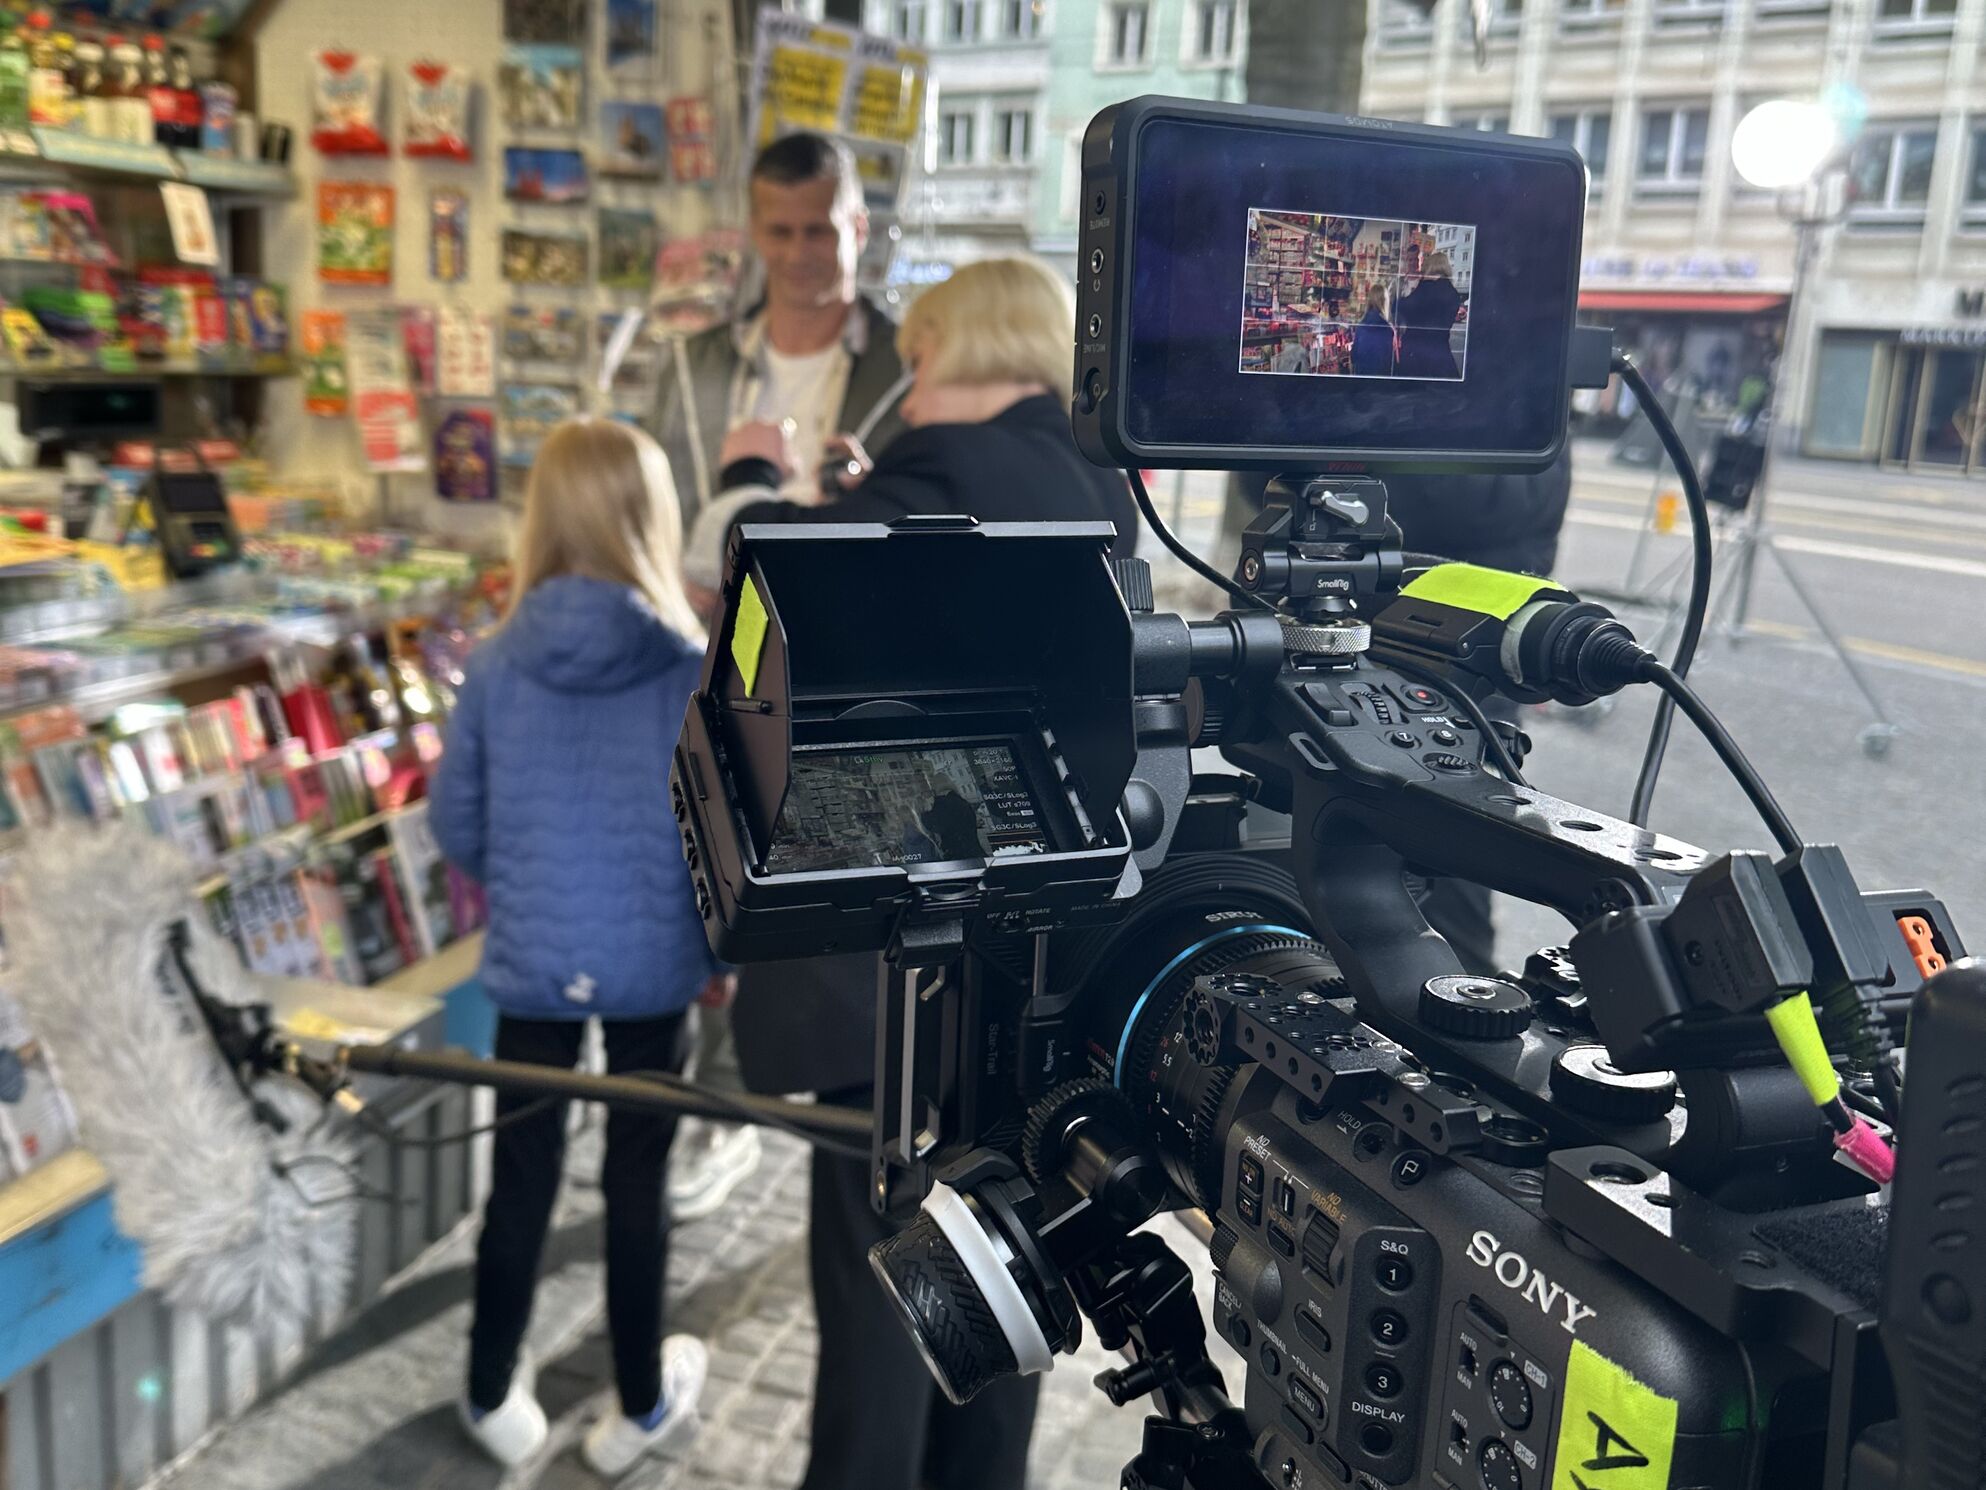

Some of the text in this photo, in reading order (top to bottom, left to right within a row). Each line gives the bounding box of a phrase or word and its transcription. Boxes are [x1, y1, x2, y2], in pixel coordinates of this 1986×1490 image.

[1317, 579, 1349, 591] SmallRig
[1337, 1110, 1361, 1130] HOLD
[1243, 1135, 1272, 1161] PRESET
[1256, 1134, 1271, 1147] ND
[1311, 1190, 1347, 1225] VARIABLE
[1327, 1192, 1341, 1206] ND
[1381, 1239, 1409, 1256] S&Q
[1388, 1268, 1397, 1281] 1
[1466, 1231, 1597, 1334] SONY
[1308, 1299, 1322, 1318] IRIS
[1257, 1319, 1288, 1354] THUMBNAIL
[1383, 1323, 1393, 1336] 2
[1460, 1332, 1478, 1351] AUTO
[1312, 1370, 1330, 1395] MENU
[1377, 1375, 1388, 1388] 3
[1457, 1371, 1472, 1390] MAN
[1525, 1361, 1547, 1388] CH-1
[1294, 1386, 1315, 1413] MENU
[1352, 1401, 1405, 1424] DISPLAY
[1451, 1409, 1468, 1429] AUTO
[1448, 1447, 1463, 1466] MAN
[1515, 1441, 1537, 1468] CH-2
